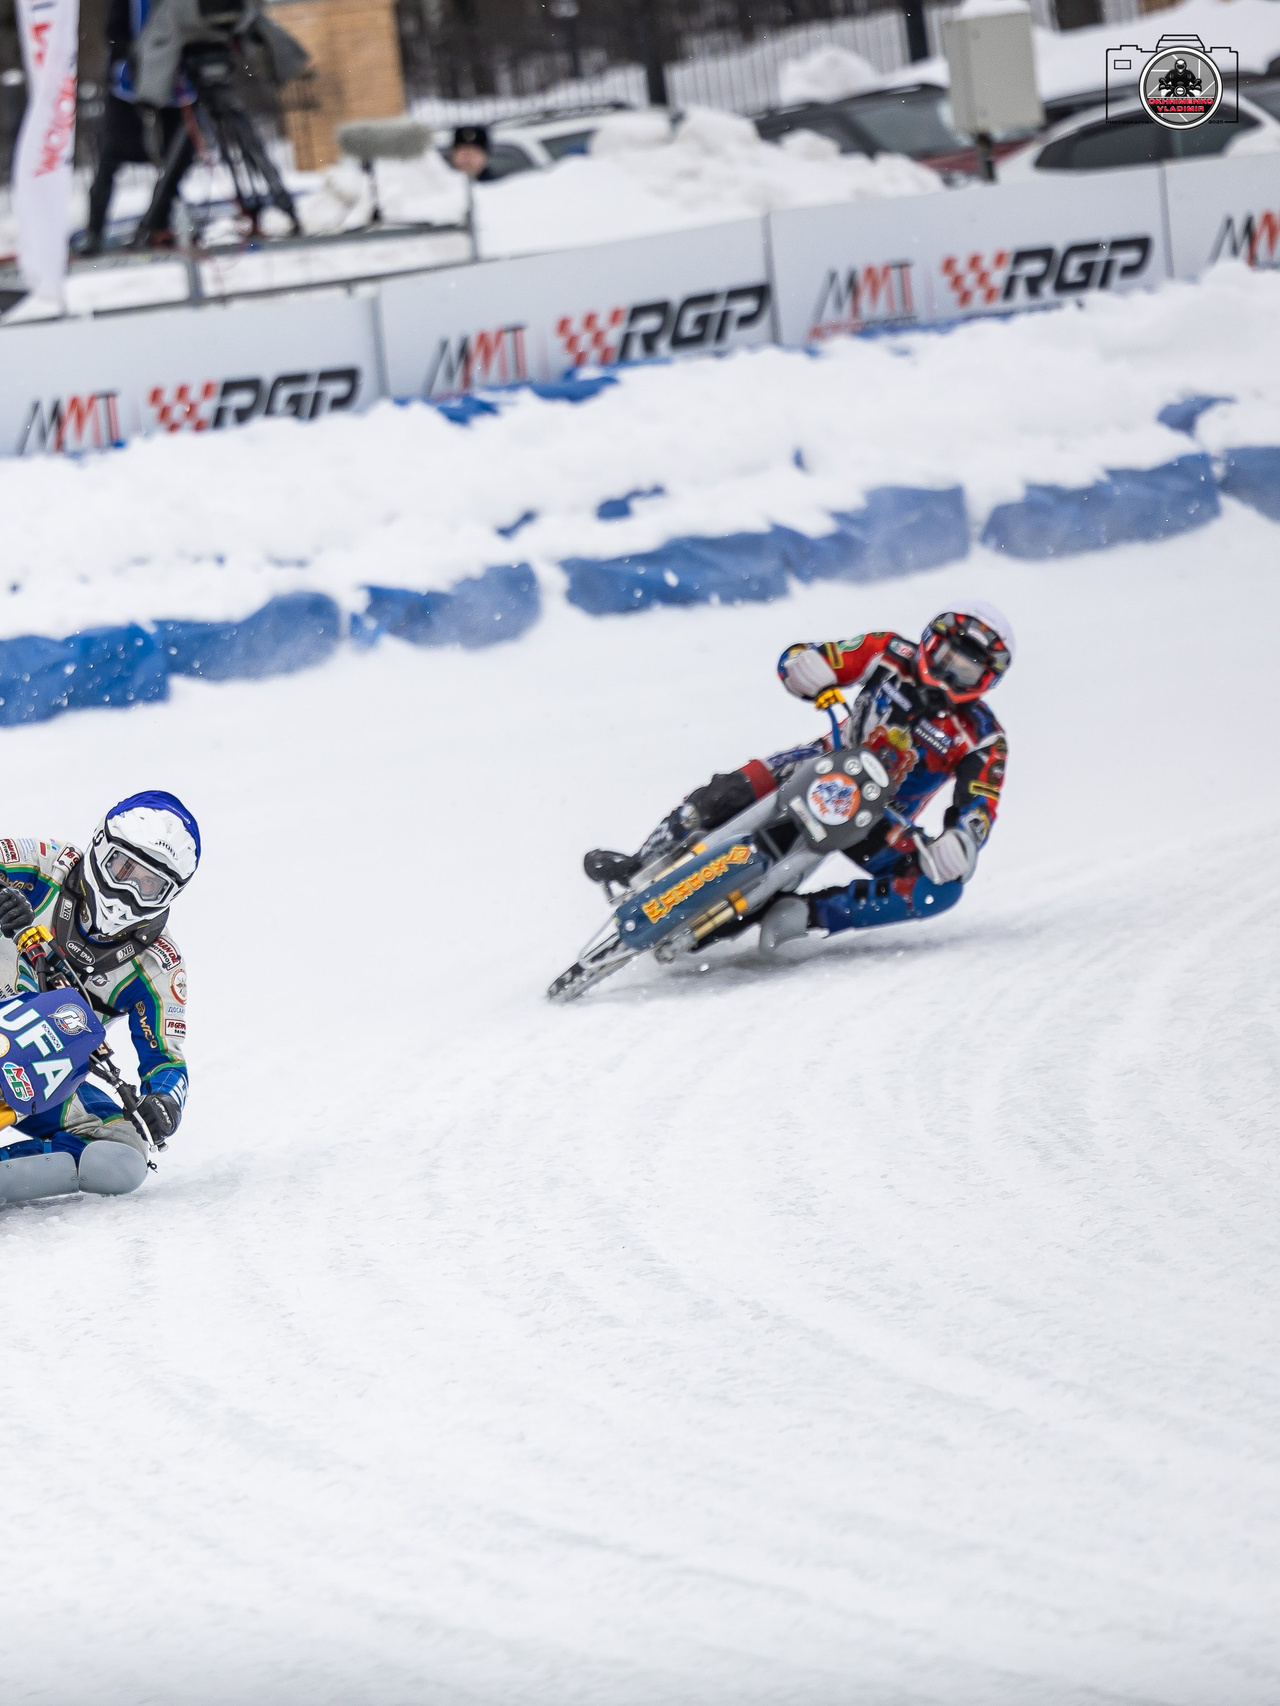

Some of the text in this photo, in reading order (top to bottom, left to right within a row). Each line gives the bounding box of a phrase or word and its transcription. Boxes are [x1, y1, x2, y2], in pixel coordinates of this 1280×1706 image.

[813, 236, 1152, 322] MMT RGP
[423, 285, 769, 396] MMT RGP
[17, 368, 359, 456] MMT RGP
